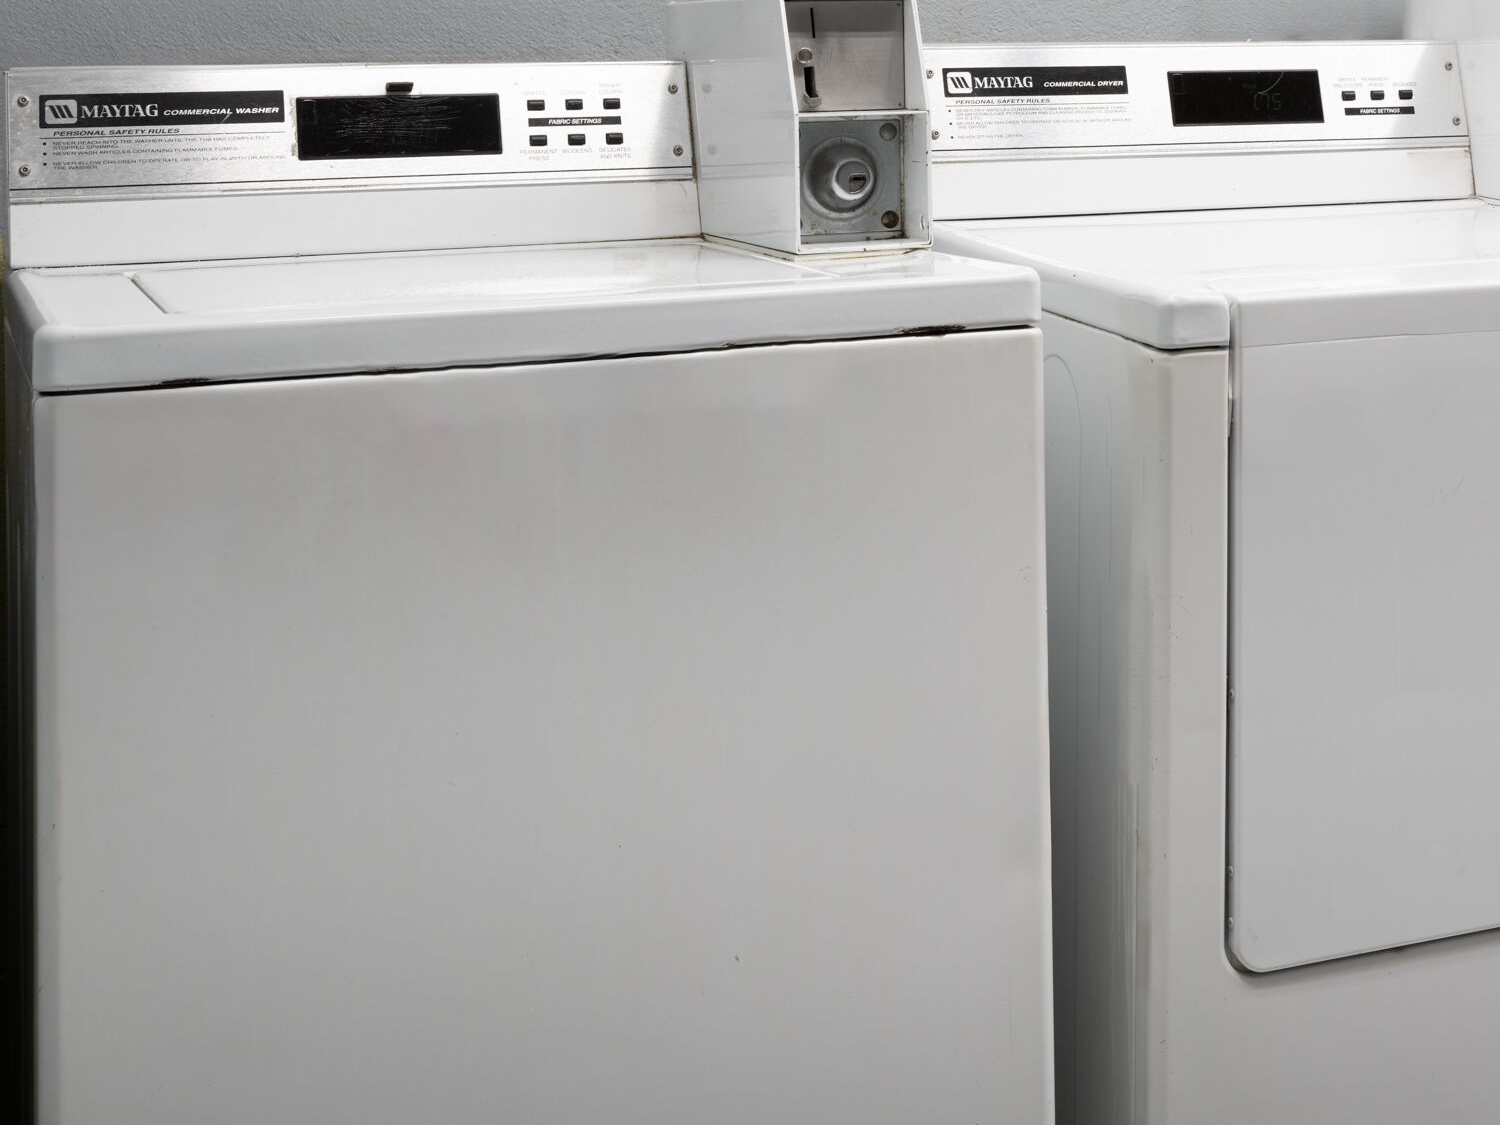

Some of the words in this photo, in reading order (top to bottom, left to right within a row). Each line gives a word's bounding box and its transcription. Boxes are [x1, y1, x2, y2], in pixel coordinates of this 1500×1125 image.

[973, 76, 1033, 89] MAYTAG
[1097, 79, 1124, 87] DRYER
[80, 103, 159, 119] MAYTAG
[163, 108, 233, 116] COMMERCIAL
